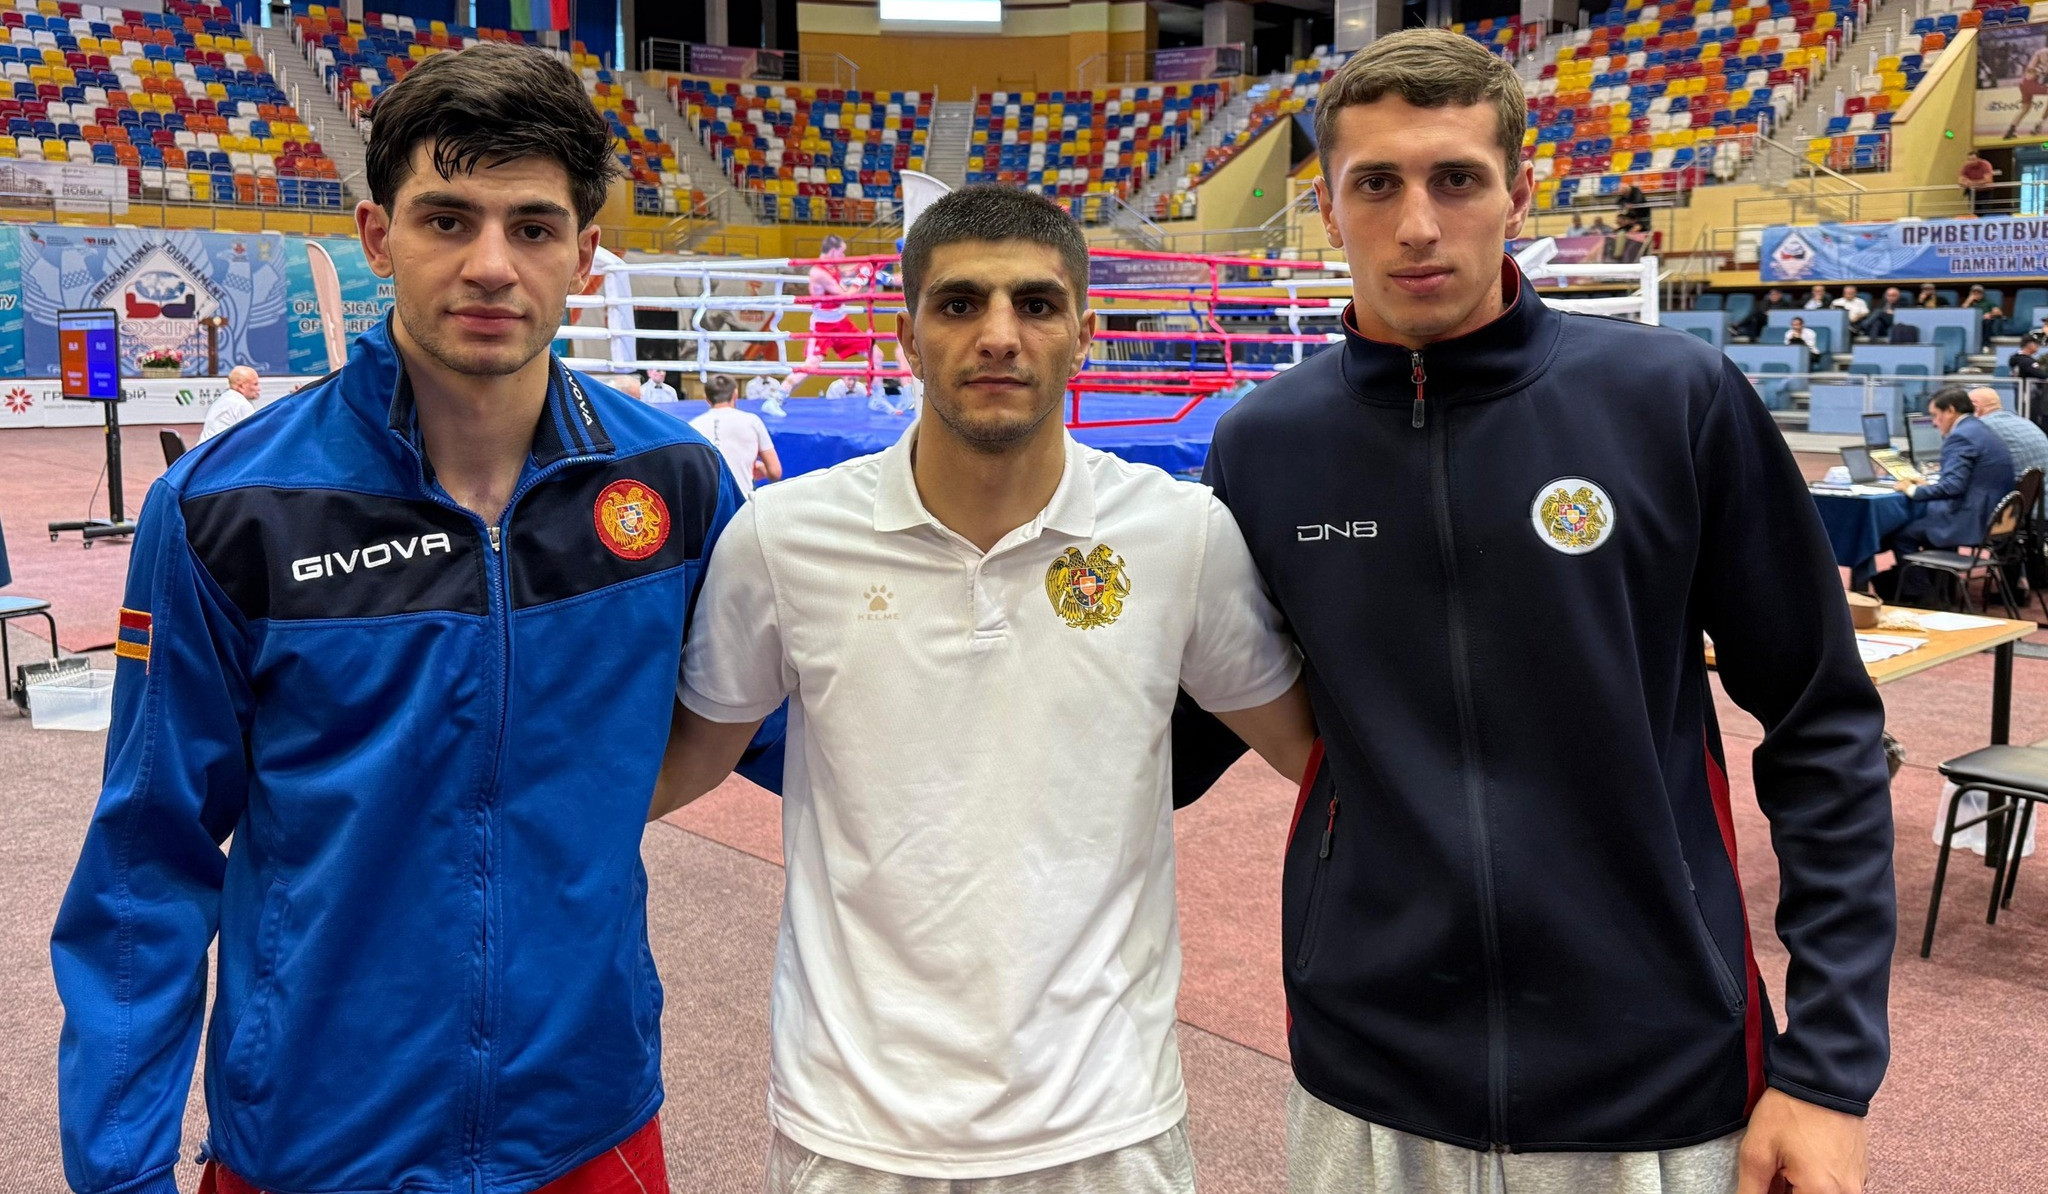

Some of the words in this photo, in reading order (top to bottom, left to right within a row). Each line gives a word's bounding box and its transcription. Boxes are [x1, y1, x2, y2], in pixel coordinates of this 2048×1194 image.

[97, 236, 117, 247] IBA
[91, 239, 157, 301] INTERNATIONAL
[160, 238, 227, 301] TOURNAMENT
[1951, 257, 2017, 271] ПАМЯТИ
[294, 301, 314, 313] OF
[1296, 521, 1378, 541] DN8
[292, 533, 451, 581] GIVOVA
[857, 612, 900, 621] KELME
